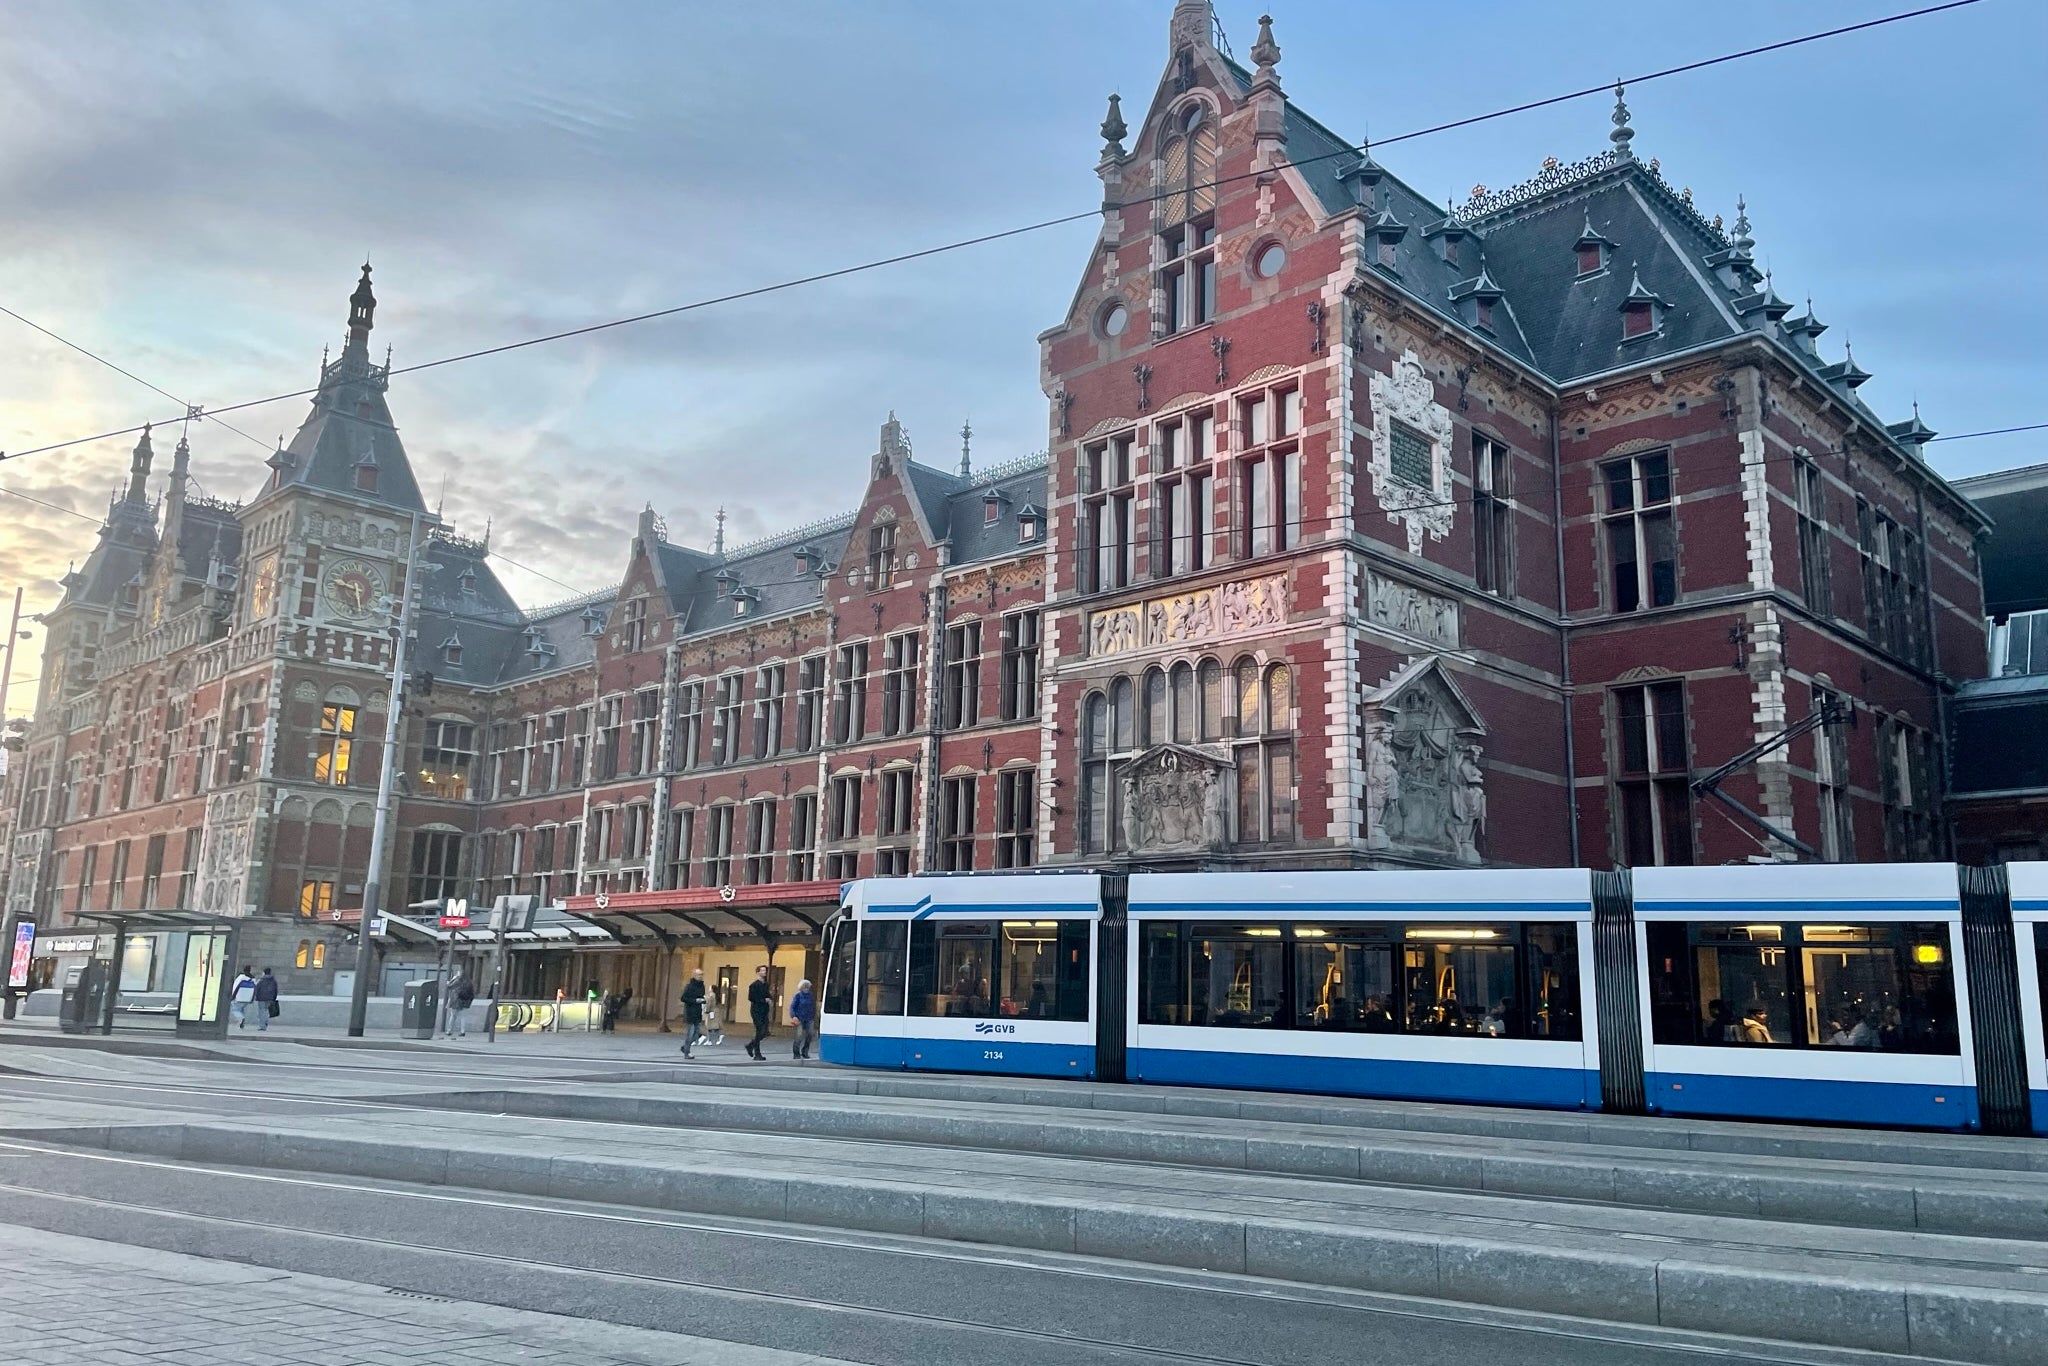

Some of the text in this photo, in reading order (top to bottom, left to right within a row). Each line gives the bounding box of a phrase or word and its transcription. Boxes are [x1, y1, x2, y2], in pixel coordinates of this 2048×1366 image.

[446, 898, 467, 917] M
[994, 1024, 1015, 1034] GVB
[983, 1050, 1003, 1060] 2134
